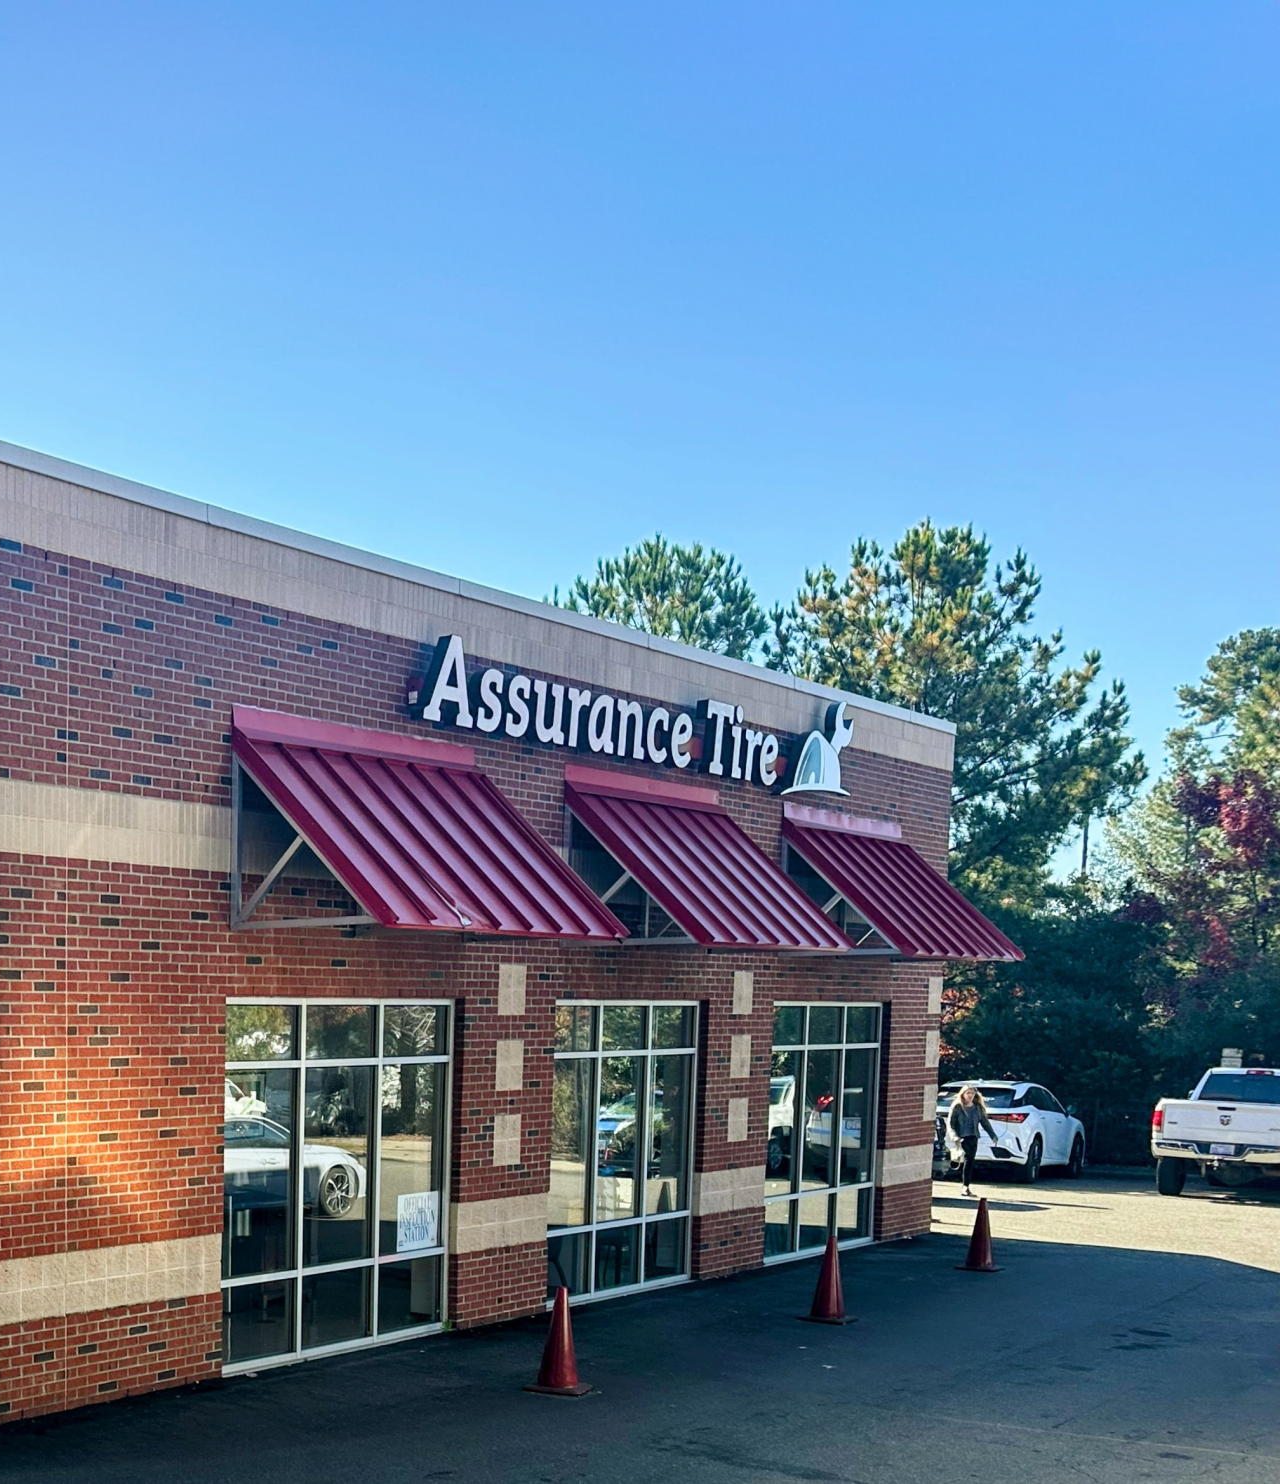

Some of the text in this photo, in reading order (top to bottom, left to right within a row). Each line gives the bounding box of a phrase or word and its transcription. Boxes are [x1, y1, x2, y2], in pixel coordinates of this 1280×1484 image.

[423, 634, 780, 787] Assurance Tire
[399, 1209, 436, 1229] INSPECTION
[403, 1225, 430, 1243] STATION
